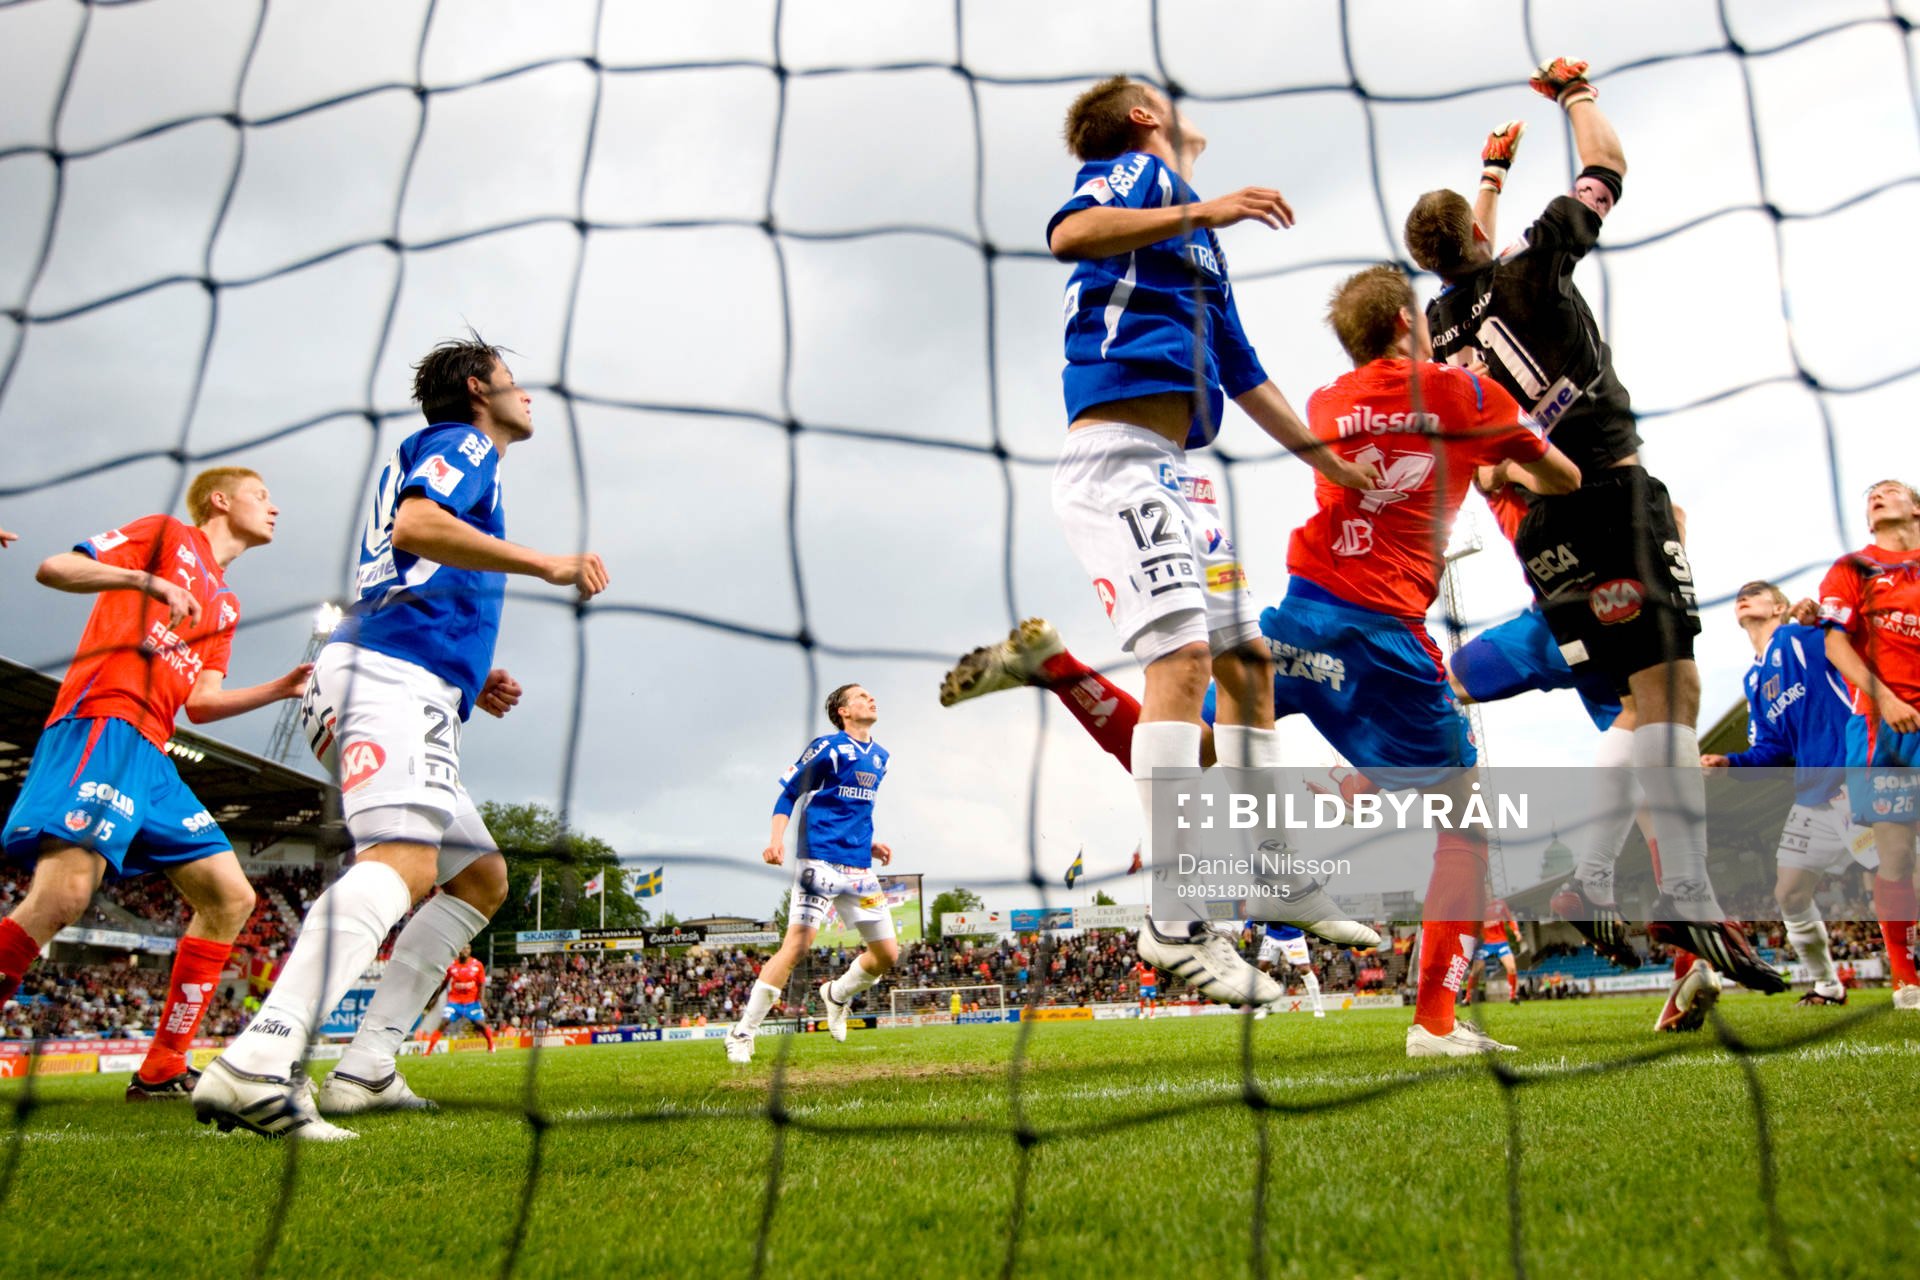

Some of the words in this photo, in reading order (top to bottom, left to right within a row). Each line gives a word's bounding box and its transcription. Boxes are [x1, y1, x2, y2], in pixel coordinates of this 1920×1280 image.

[1336, 405, 1441, 439] nilsson
[458, 432, 478, 456] TOP
[1118, 501, 1181, 551] 12
[1591, 581, 1642, 615] AXA
[1261, 634, 1346, 674] RESUNDS
[1273, 655, 1346, 692] RAFT
[78, 781, 135, 817] SOLID
[93, 818, 116, 842] 15
[523, 931, 575, 942] SKANSKA
[708, 932, 778, 944] Handelsbanken
[597, 1032, 623, 1043] NVS
[631, 1030, 658, 1041] NVS
